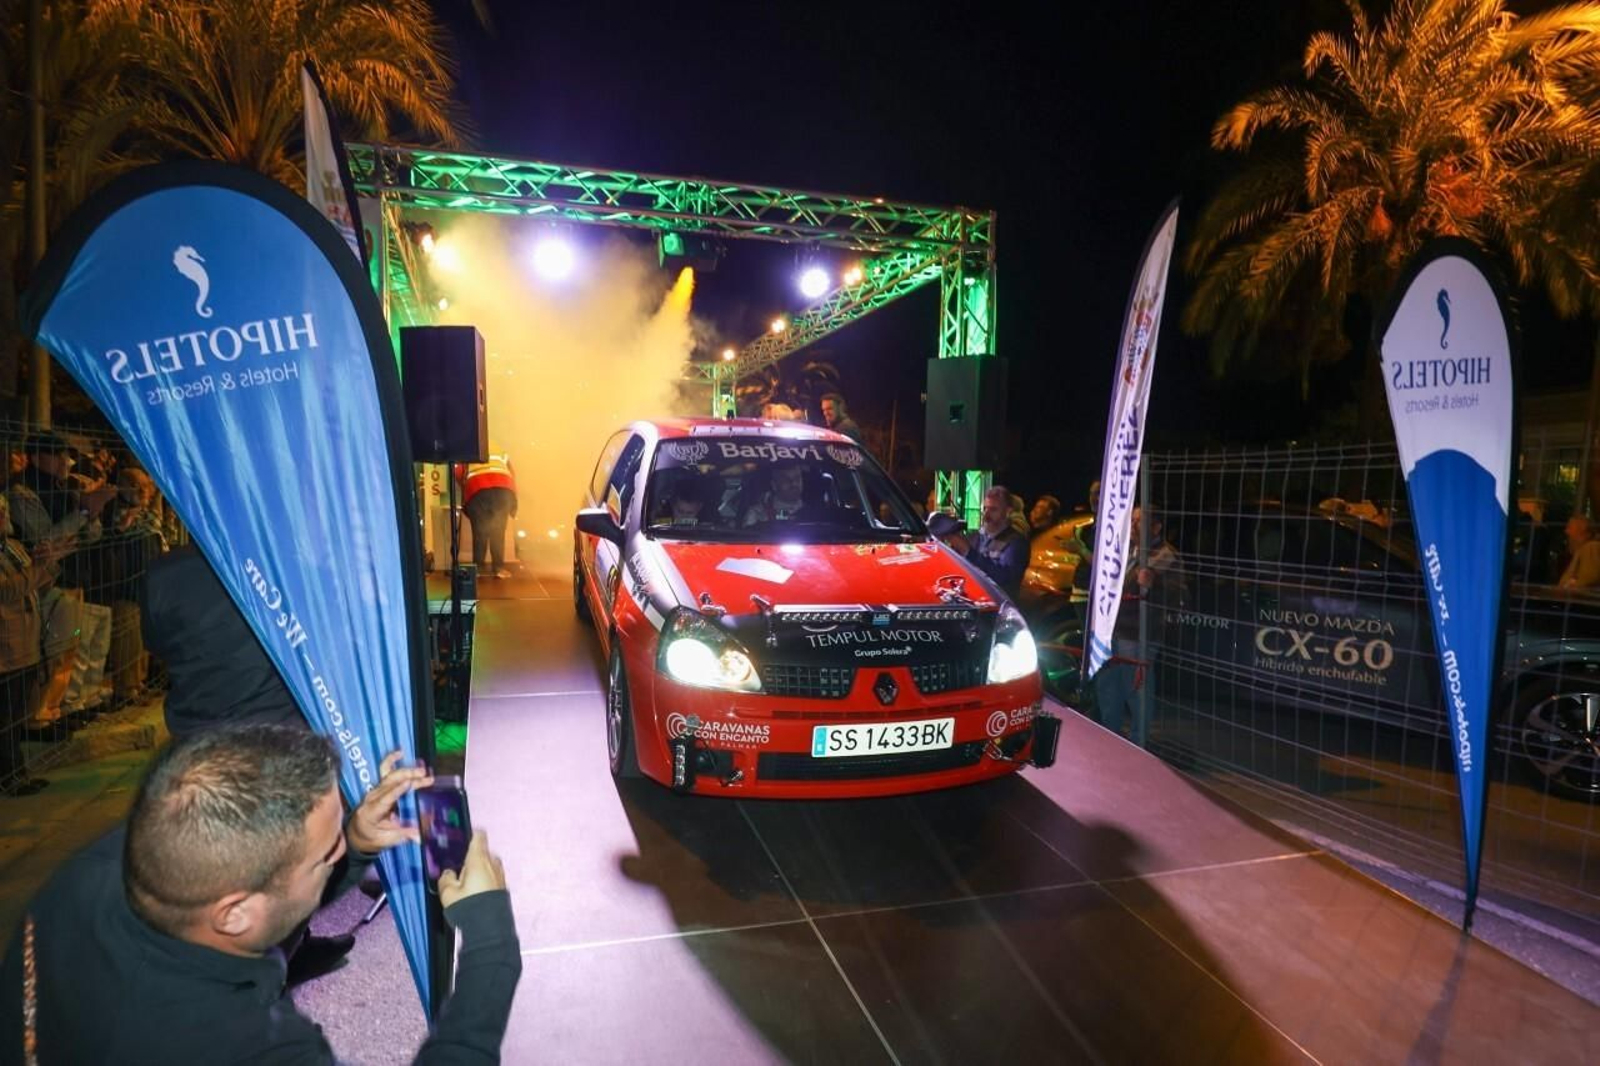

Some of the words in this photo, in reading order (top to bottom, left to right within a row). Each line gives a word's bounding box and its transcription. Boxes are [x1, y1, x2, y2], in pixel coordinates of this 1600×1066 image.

[717, 442, 823, 462] BarJavi
[1177, 613, 1230, 630] MOTOR
[1259, 608, 1319, 627] NUEVO
[1323, 615, 1395, 636] MAZDA
[805, 631, 878, 648] TEMPUL
[881, 629, 944, 642] MOTOR
[854, 649, 882, 658] Grupo
[1255, 626, 1395, 671] CX-60
[1307, 665, 1388, 685] enchufable
[694, 730, 717, 740] CON
[720, 732, 770, 744] ENCANTO
[698, 720, 771, 736] CARAVANAS
[829, 729, 858, 752] SS
